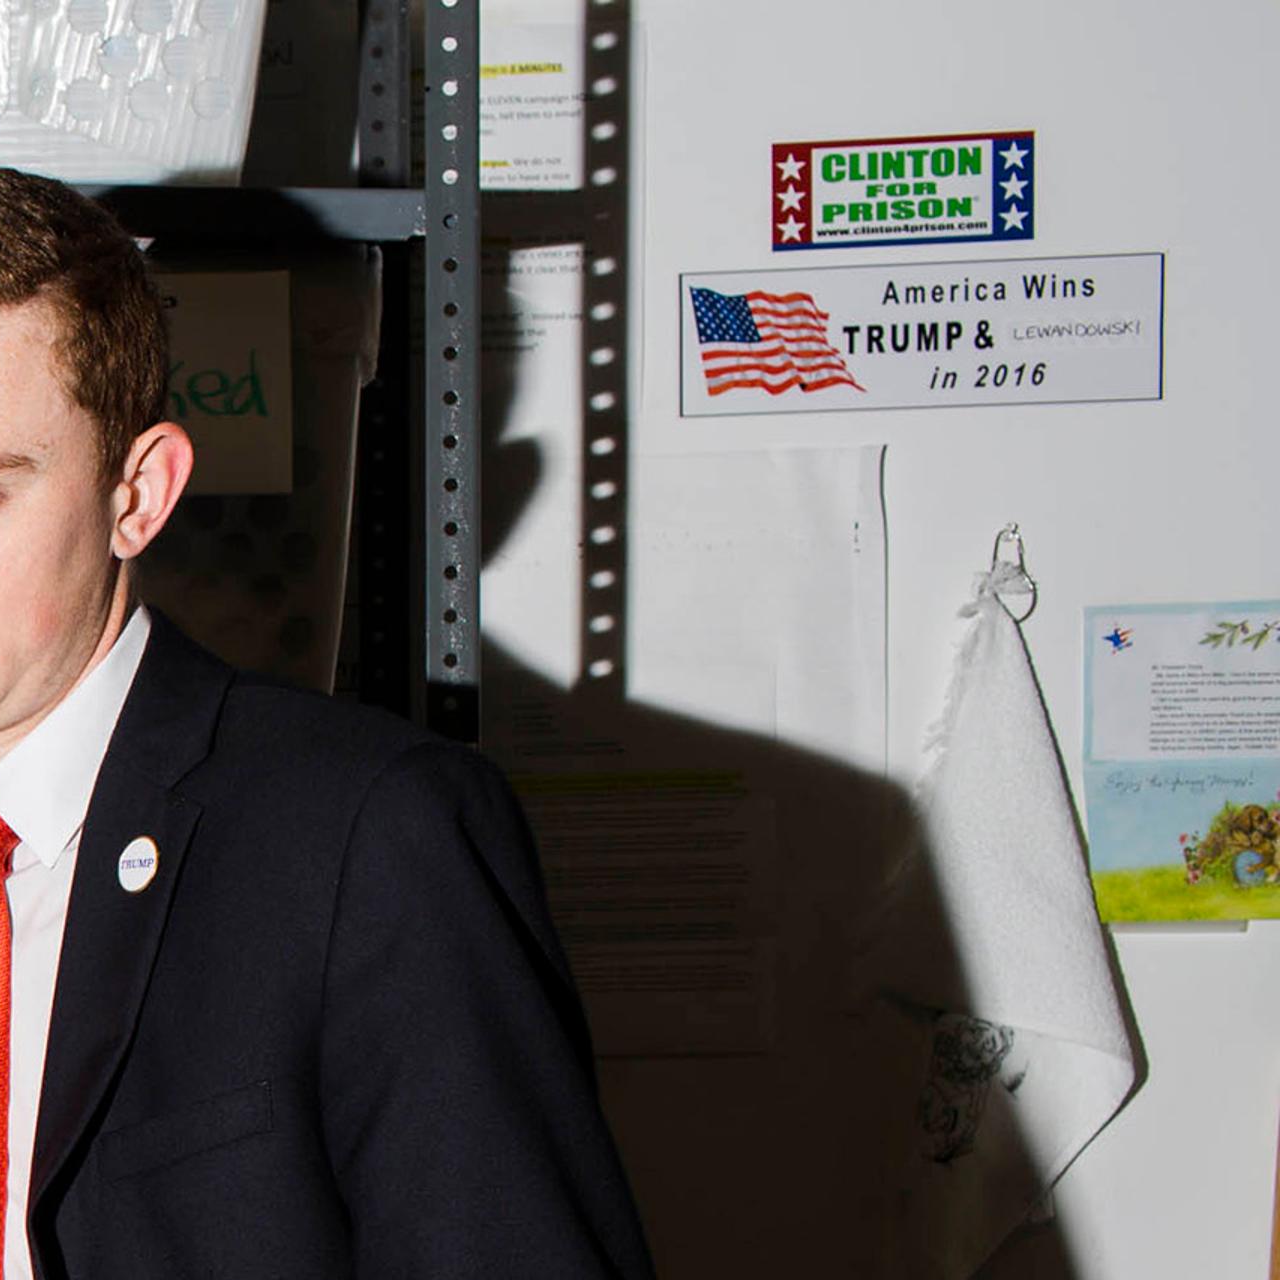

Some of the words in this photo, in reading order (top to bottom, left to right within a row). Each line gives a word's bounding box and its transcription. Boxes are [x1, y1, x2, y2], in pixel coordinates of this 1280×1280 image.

[821, 146, 983, 184] CLINTON
[865, 182, 938, 199] FOR
[821, 196, 974, 225] PRISON
[816, 219, 989, 238] www.clinton4prison.com
[882, 277, 1007, 306] America
[1022, 272, 1096, 300] Wins
[842, 320, 964, 355] TRUMP
[974, 320, 994, 350] &
[1012, 320, 1142, 342] LEWANDOWSKI
[930, 367, 957, 391] in
[974, 361, 1047, 389] 2016
